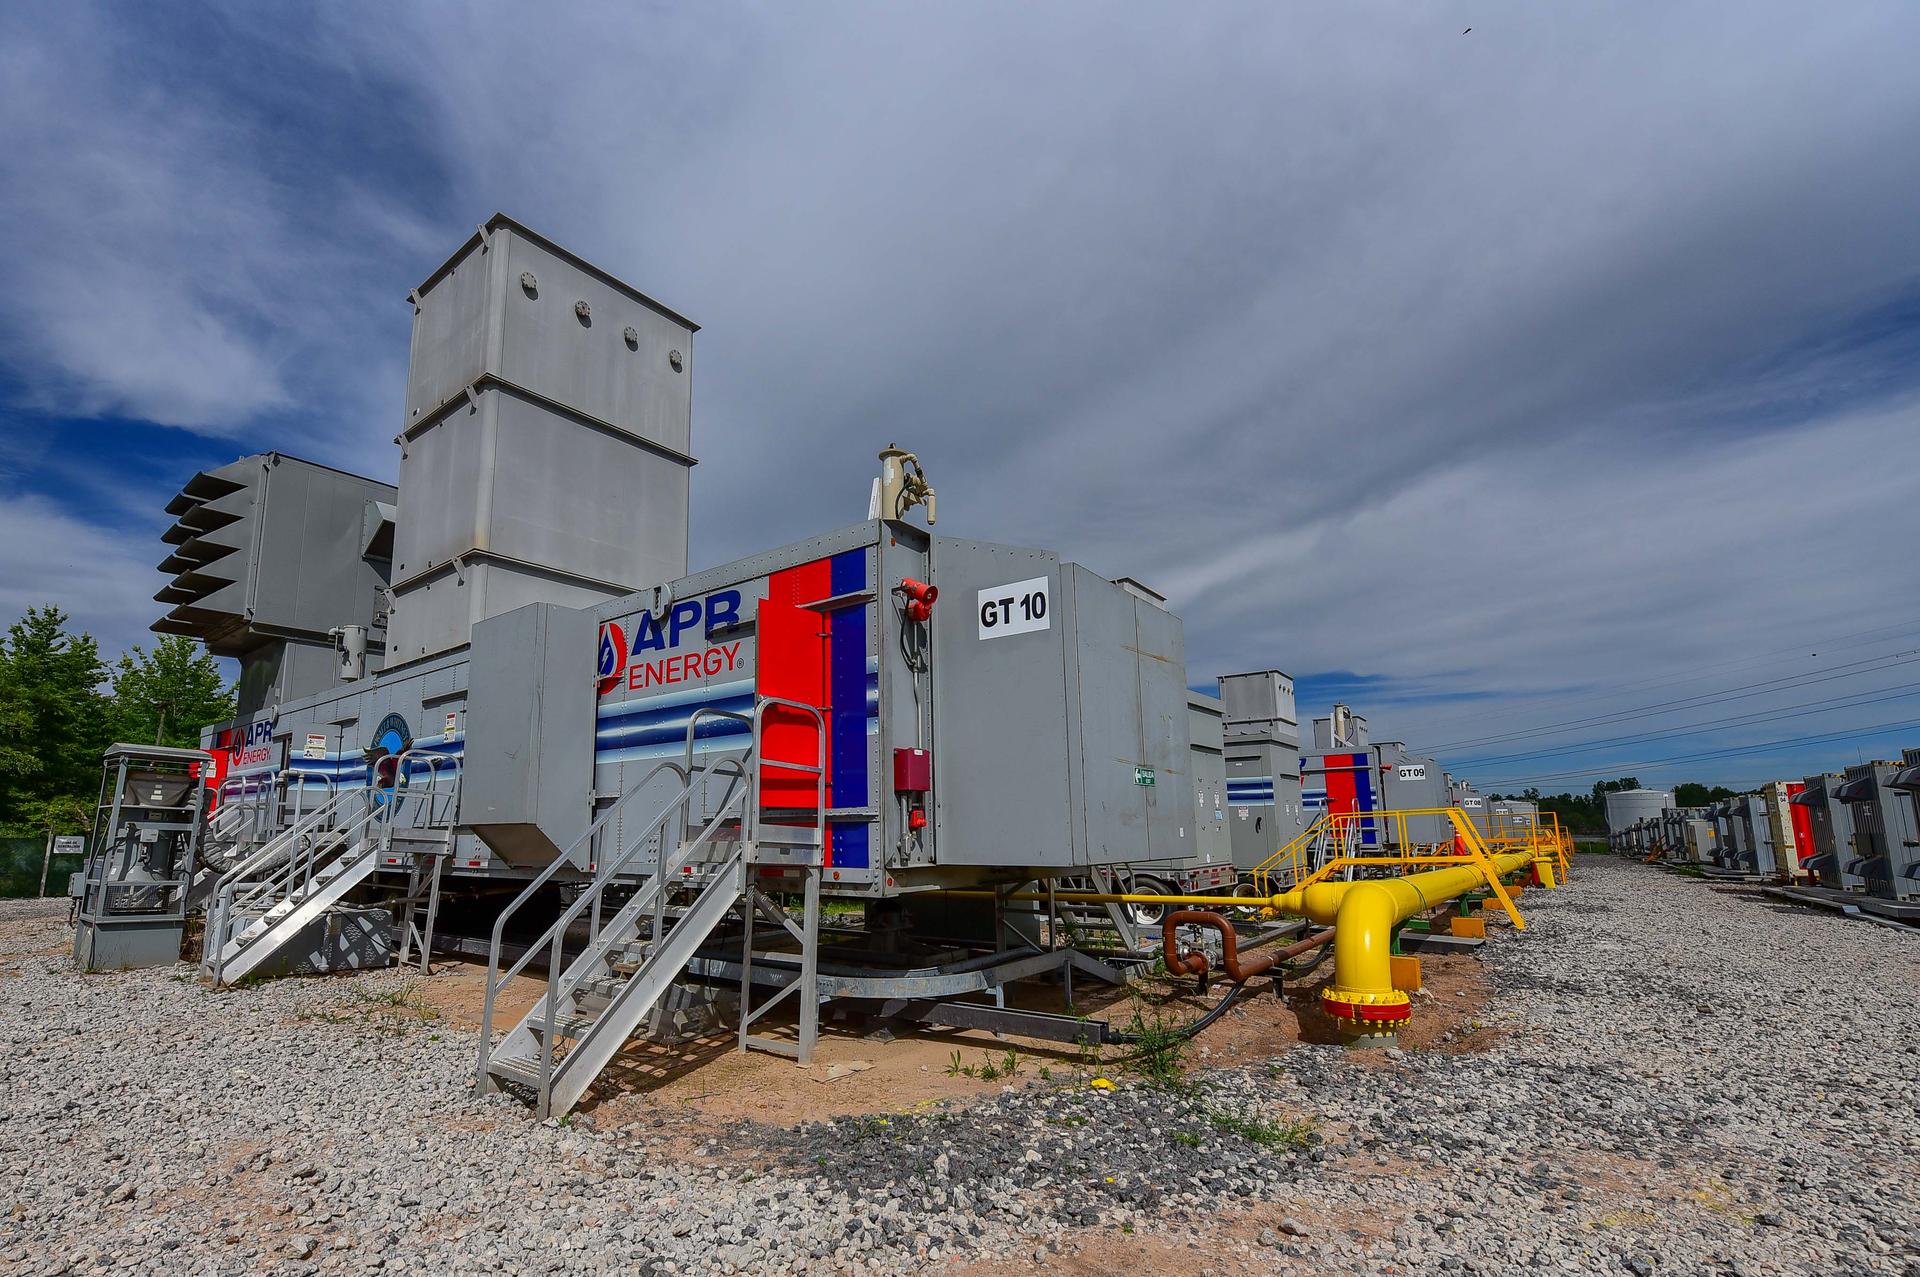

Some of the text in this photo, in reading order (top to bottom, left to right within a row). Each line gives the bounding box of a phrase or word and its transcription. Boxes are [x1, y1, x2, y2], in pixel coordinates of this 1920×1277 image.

[980, 591, 1047, 628] GT 10
[628, 641, 741, 691] ENERGY
[245, 720, 273, 747] APR
[243, 746, 272, 765] ENERGY
[1399, 768, 1425, 778] GT 09
